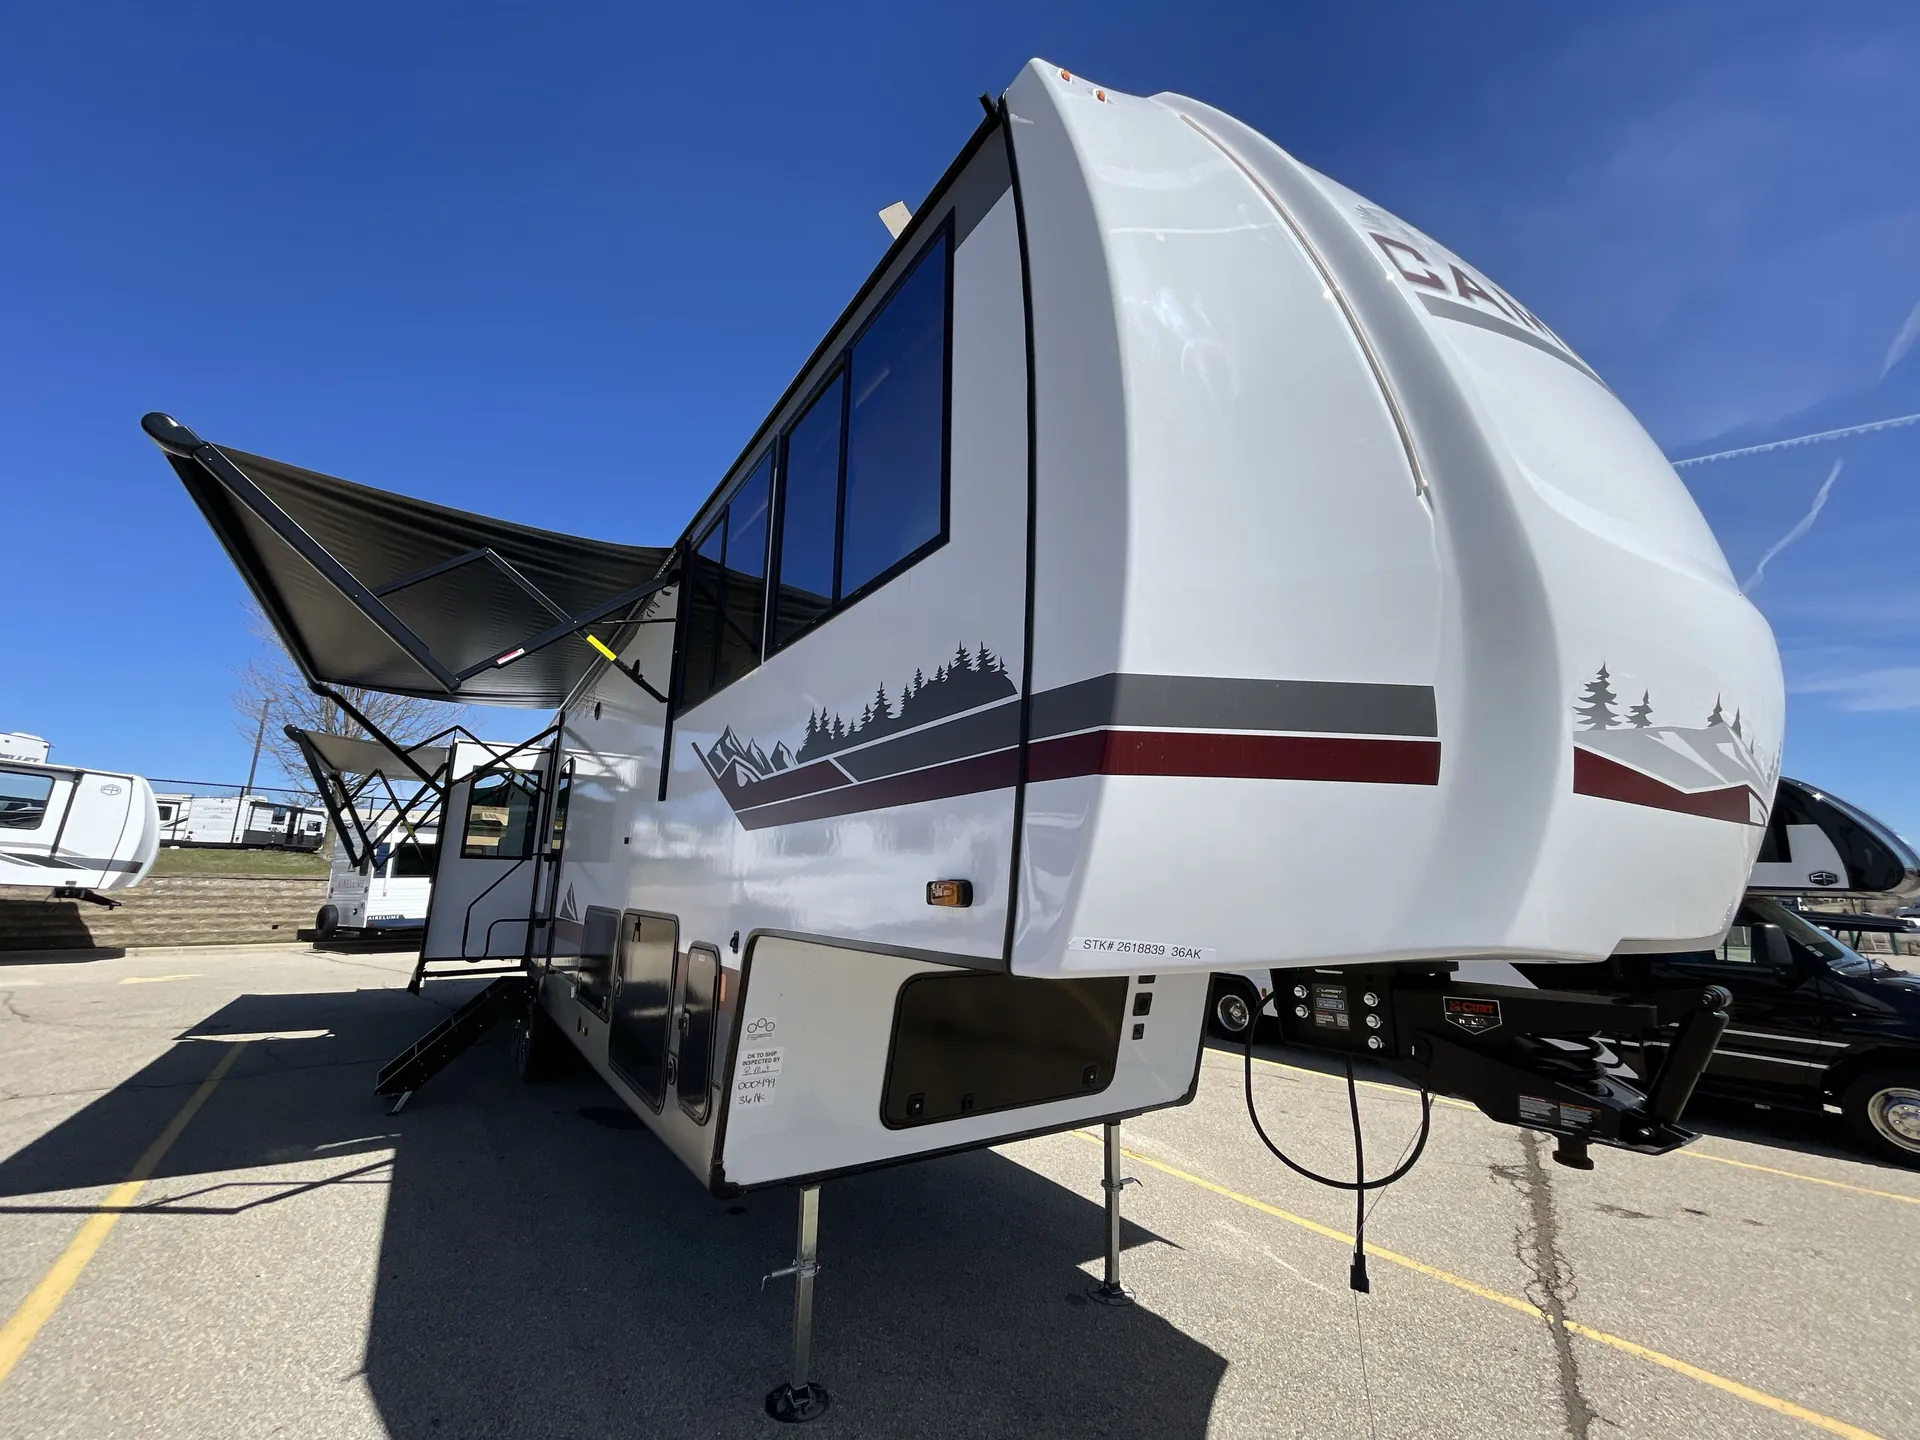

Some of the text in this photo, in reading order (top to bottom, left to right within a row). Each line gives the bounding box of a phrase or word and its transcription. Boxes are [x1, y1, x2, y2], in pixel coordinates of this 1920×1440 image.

[0, 753, 40, 762] ULLET
[1083, 939, 1202, 959] STK# 2618839 36AK
[742, 1058, 772, 1066] INSPECTED
[738, 1078, 775, 1090] 000499
